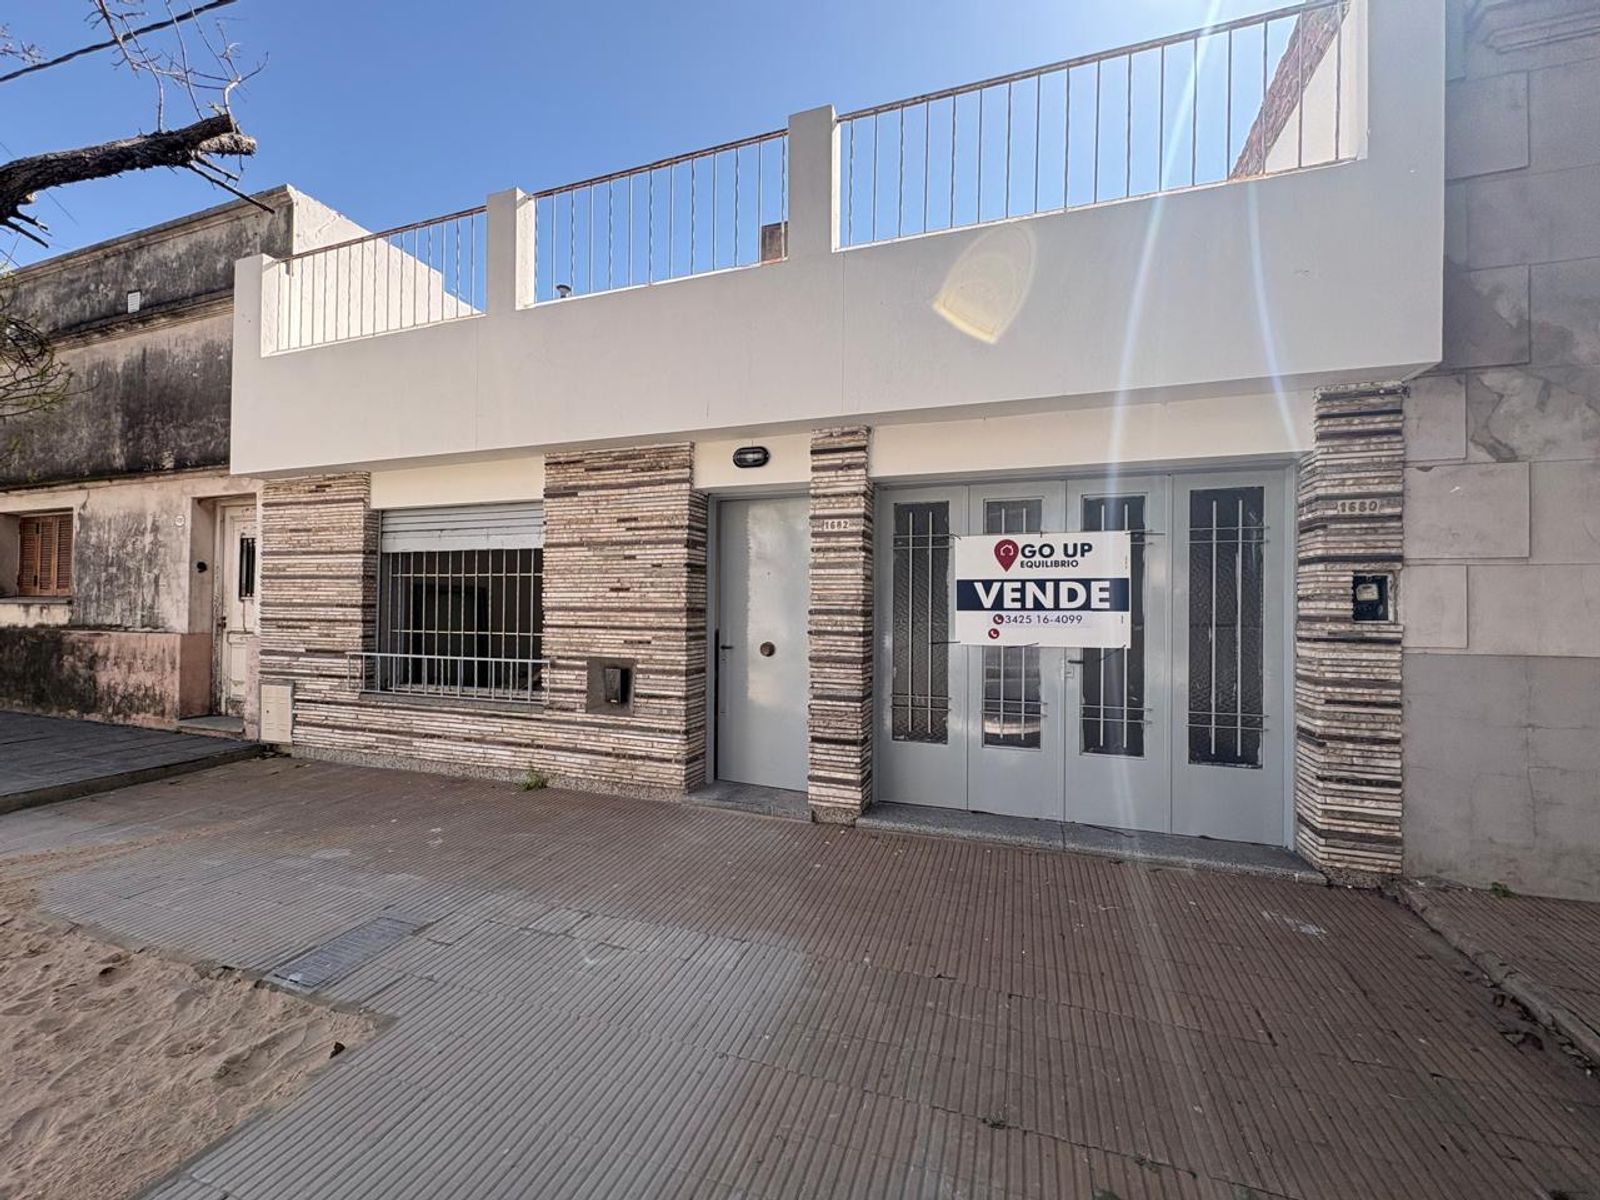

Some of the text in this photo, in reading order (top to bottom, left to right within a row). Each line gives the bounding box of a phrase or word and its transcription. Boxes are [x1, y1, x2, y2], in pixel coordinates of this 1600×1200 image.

[1020, 542, 1093, 559] GO UP
[1020, 559, 1079, 569] EQUILIBRIO
[973, 580, 1111, 609] VENDE
[1005, 614, 1083, 624] 3425 16-4099
